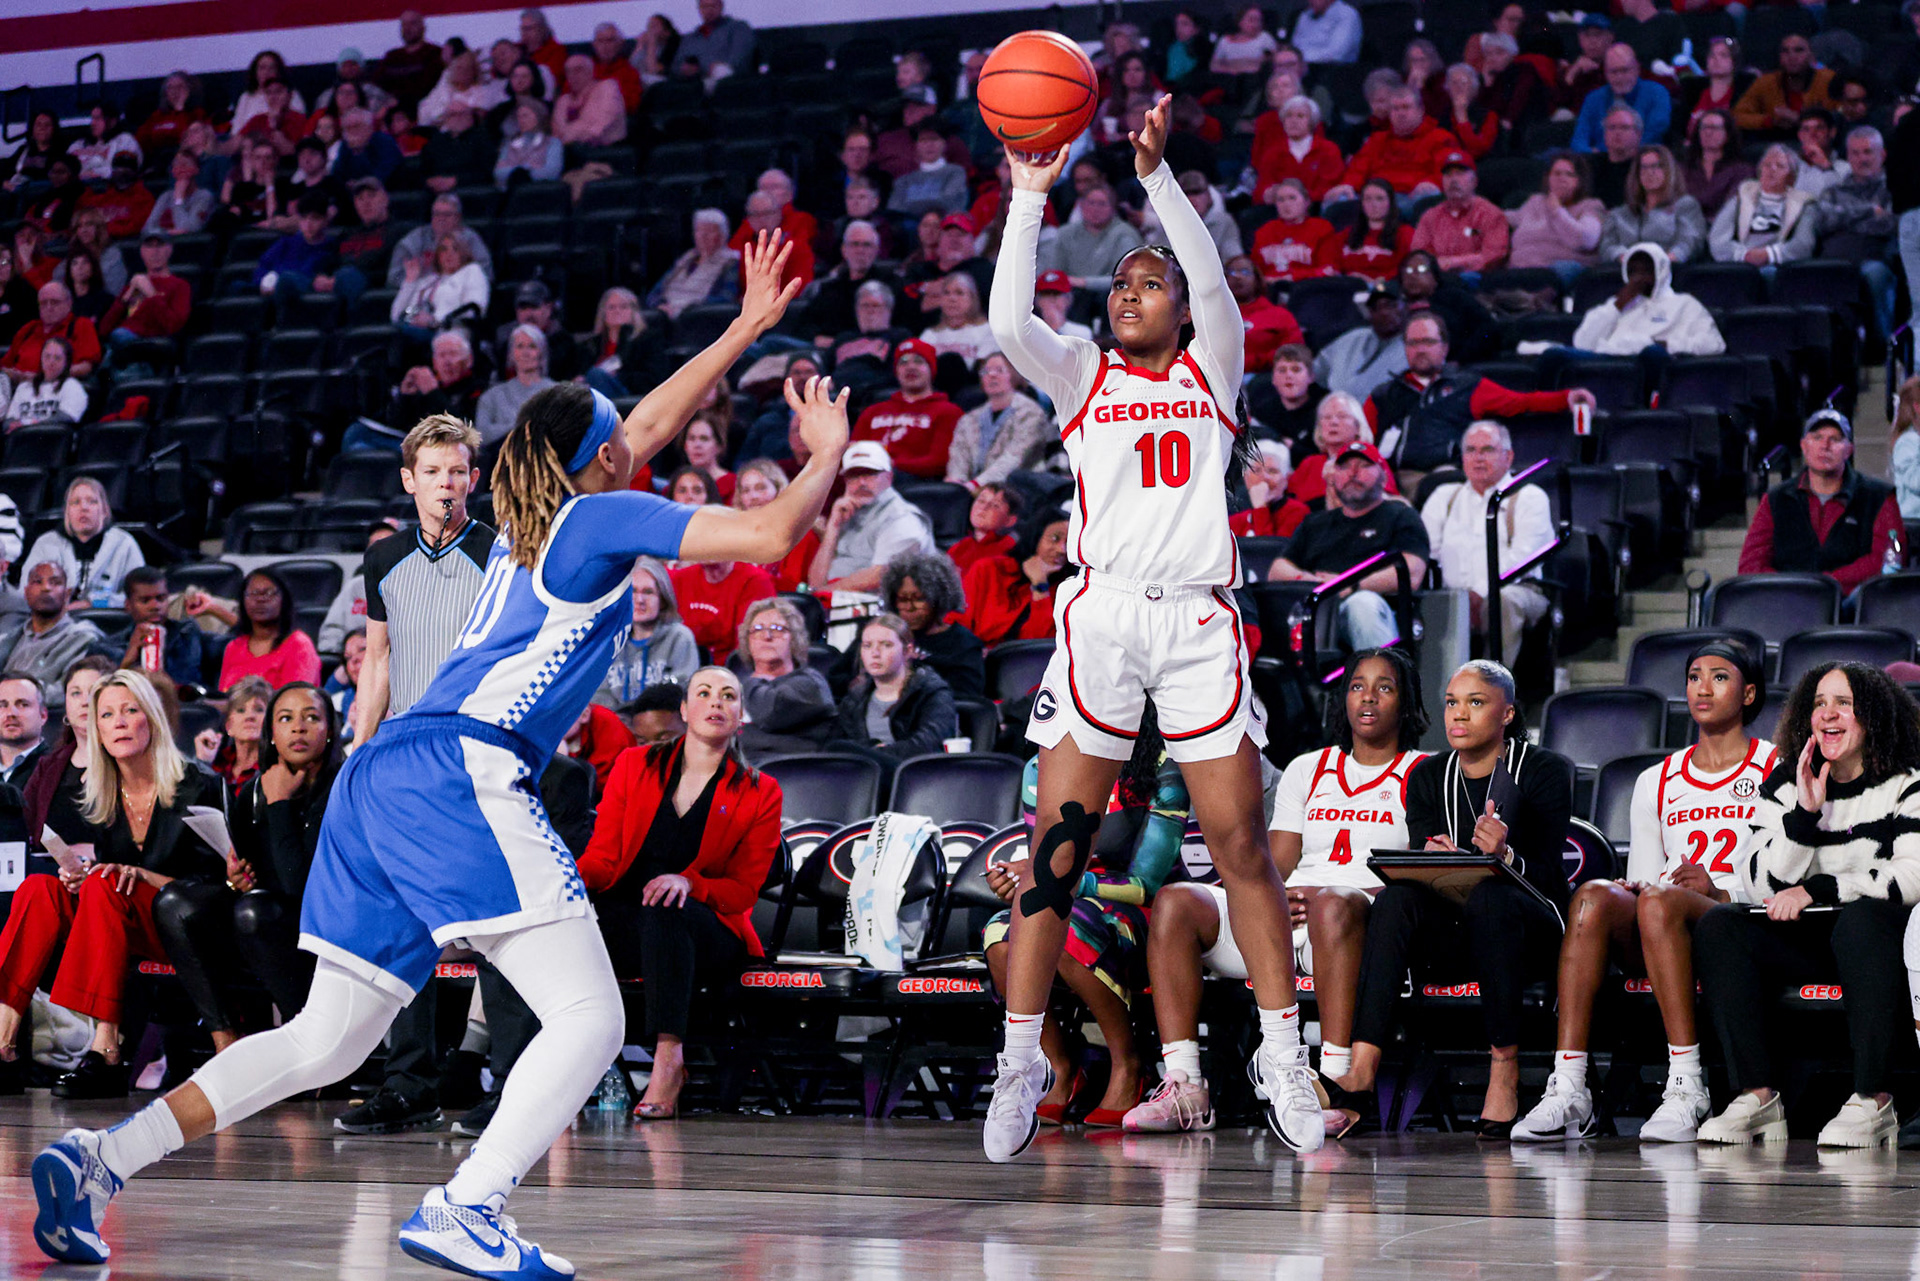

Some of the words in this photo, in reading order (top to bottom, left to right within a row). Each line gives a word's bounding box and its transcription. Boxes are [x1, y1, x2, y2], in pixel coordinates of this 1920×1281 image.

[1094, 400, 1214, 424] GEORGIA
[1135, 430, 1191, 488] 10
[1034, 689, 1057, 721] G
[1734, 779, 1754, 797] SEC
[1307, 808, 1394, 825] GEORGIA
[1327, 829, 1353, 866] 4
[1687, 828, 1738, 874] 22
[741, 972, 823, 988] GEORGIA
[898, 977, 982, 993] GEORGIA
